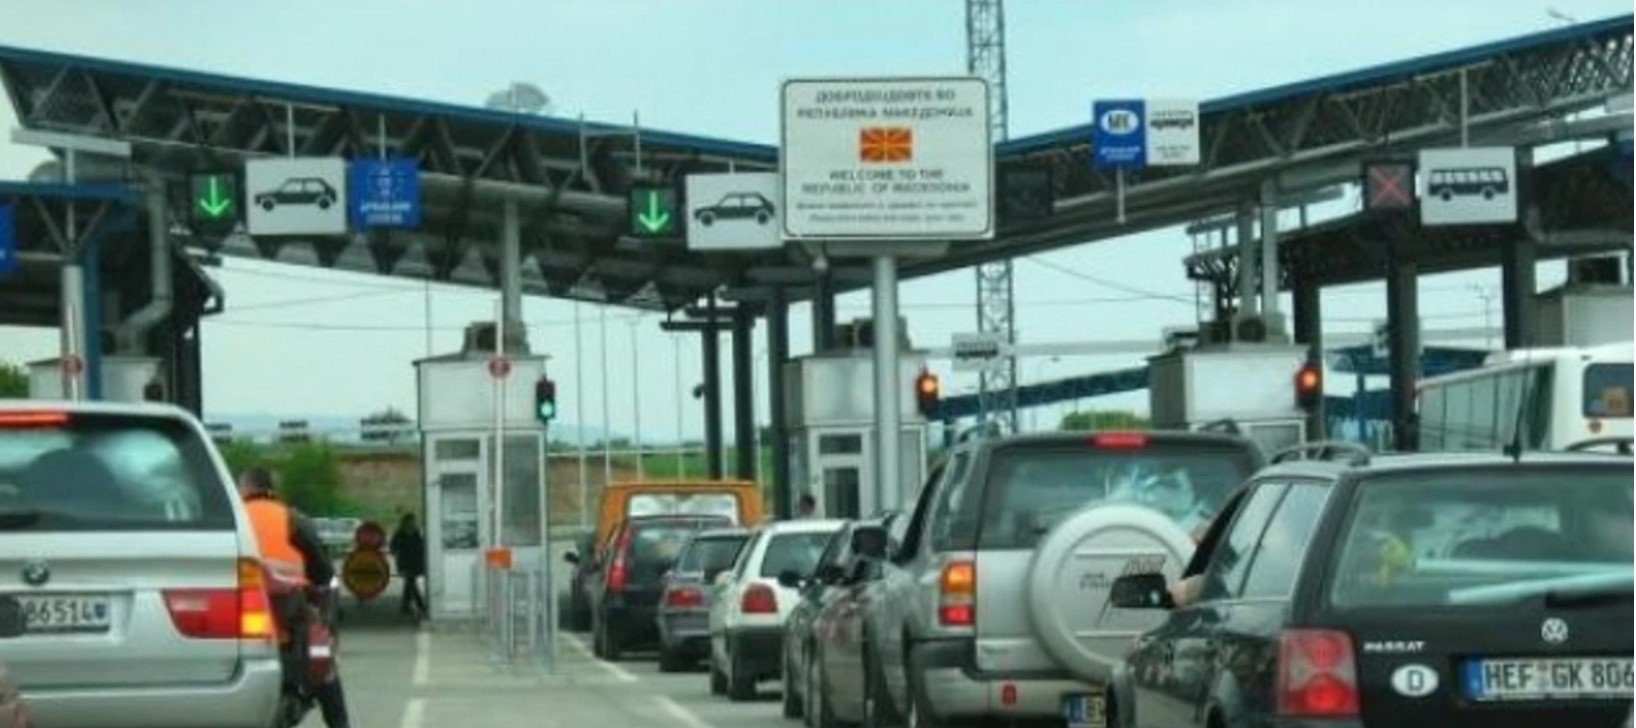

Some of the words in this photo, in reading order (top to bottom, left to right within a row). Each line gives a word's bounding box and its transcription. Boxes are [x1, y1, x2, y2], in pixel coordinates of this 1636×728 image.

[797, 107, 877, 119] РЕПУБЛИКА
[882, 107, 973, 120] МАКЕДОНИЈА
[829, 169, 893, 180] WELCOME
[899, 169, 916, 179] TO
[920, 169, 943, 178] THE
[802, 182, 865, 194] REPUBLIC
[871, 182, 888, 194] OF
[892, 182, 971, 193] MACEDONIA
[1406, 669, 1425, 691] D
[1485, 663, 1534, 690] HEF
[1552, 663, 1584, 689] GK
